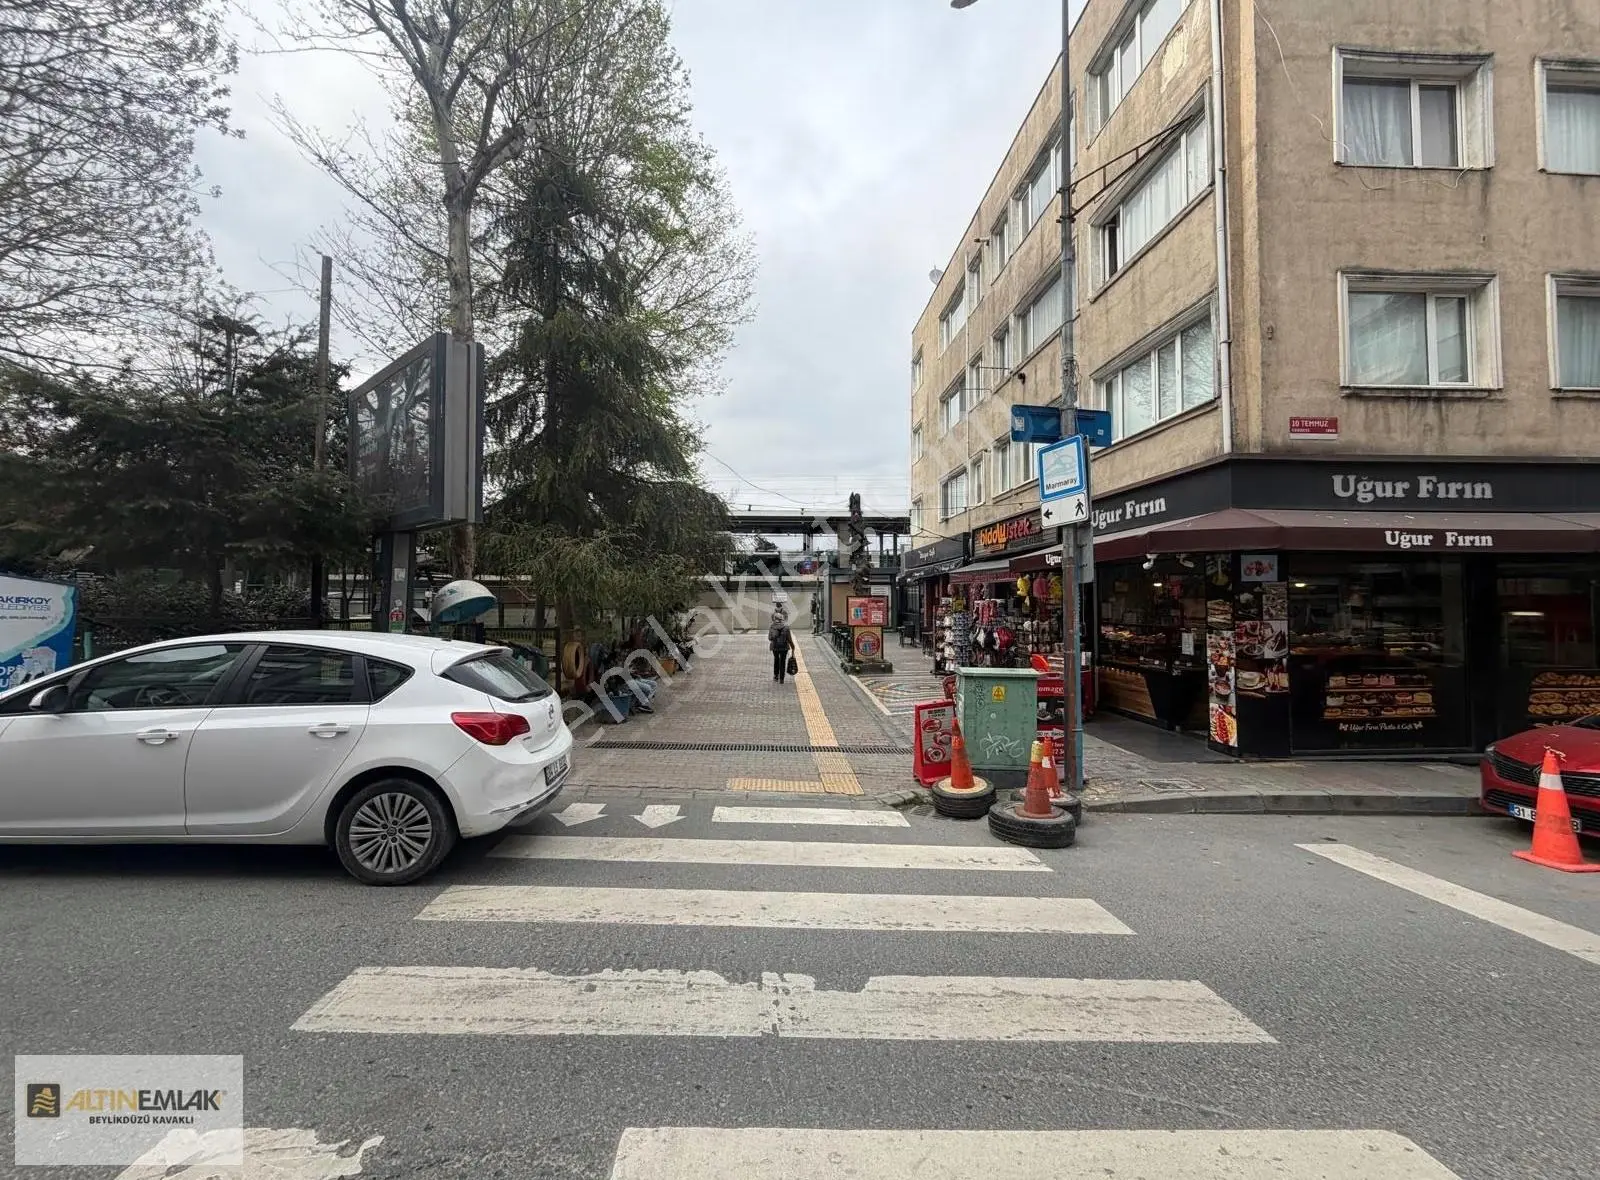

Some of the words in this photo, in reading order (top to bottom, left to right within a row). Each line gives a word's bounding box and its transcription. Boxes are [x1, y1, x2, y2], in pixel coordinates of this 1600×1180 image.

[1301, 419, 1328, 428] TEMMUZ
[1045, 478, 1077, 490] Marmaray
[1332, 474, 1410, 503] Uğur
[1417, 475, 1493, 499] Fırın
[1091, 508, 1122, 529] Uğur
[1124, 497, 1166, 520] Fırın
[1385, 530, 1434, 549] Uğur
[1445, 532, 1493, 547] Fırın
[1514, 806, 1526, 818] 31
